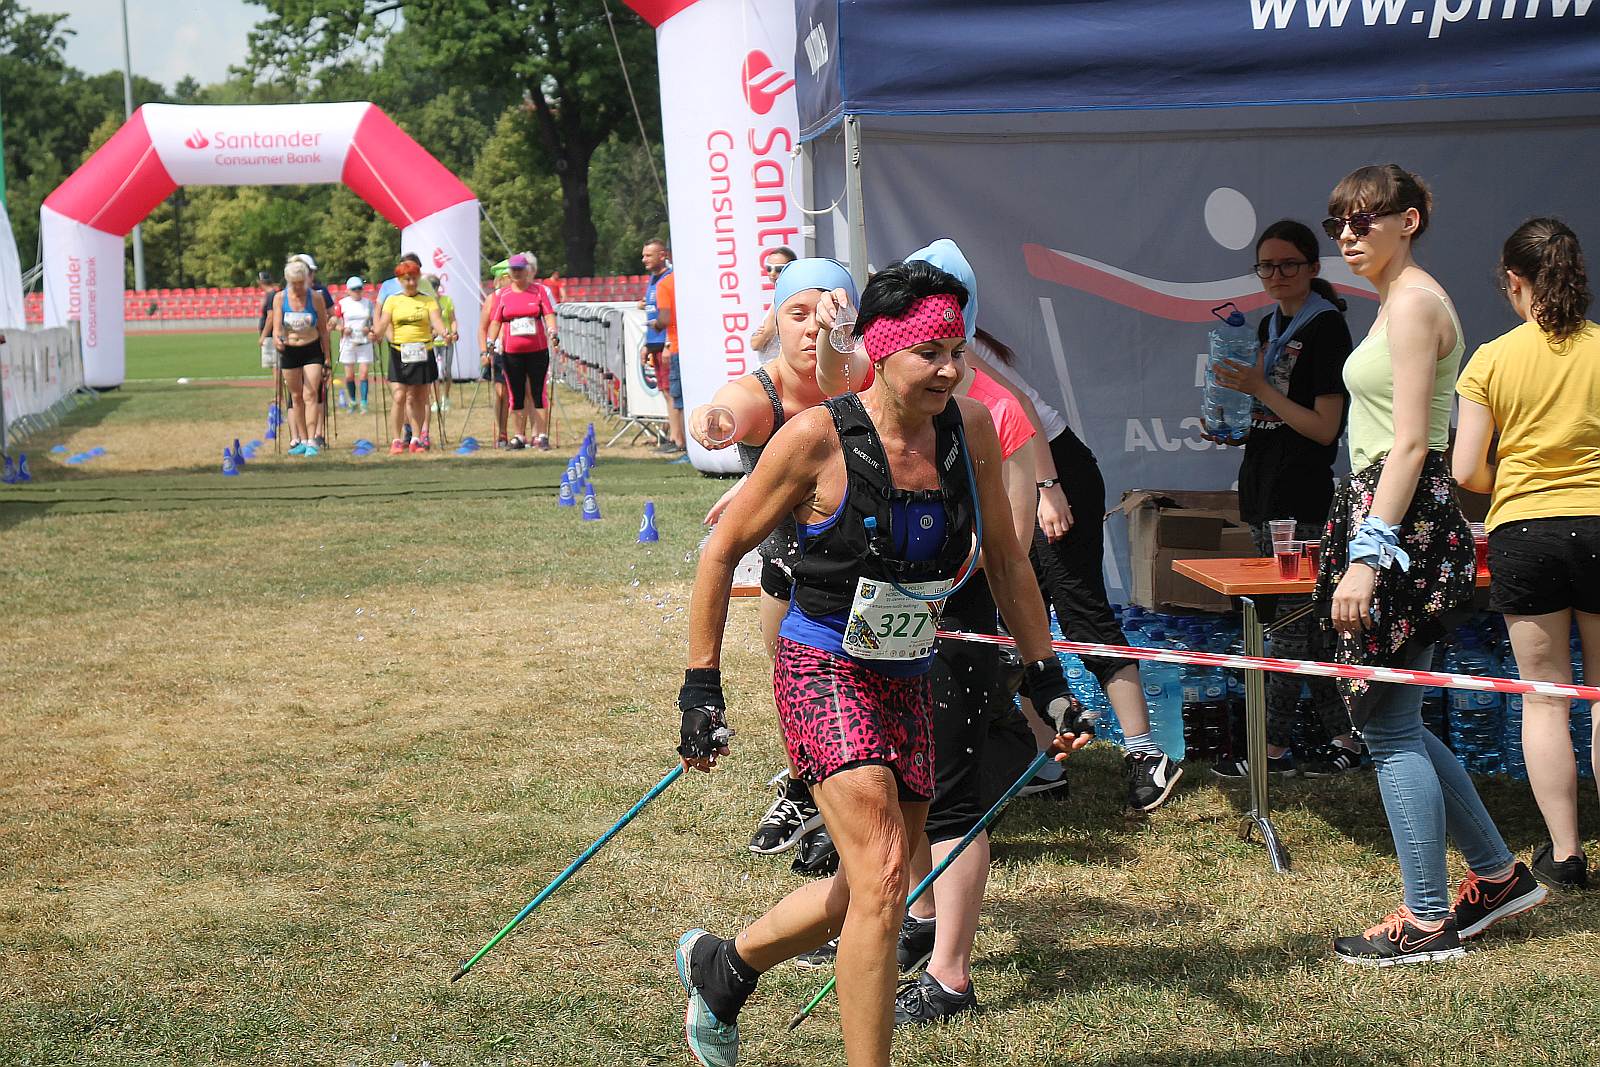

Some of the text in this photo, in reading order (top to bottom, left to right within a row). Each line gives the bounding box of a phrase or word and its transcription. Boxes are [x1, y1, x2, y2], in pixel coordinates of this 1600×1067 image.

[214, 130, 322, 149] Santander
[215, 152, 321, 166] Consumer Bank
[707, 129, 750, 383] Consumer Ban
[85, 256, 97, 348] Consumer Bank
[876, 612, 929, 638] 327
